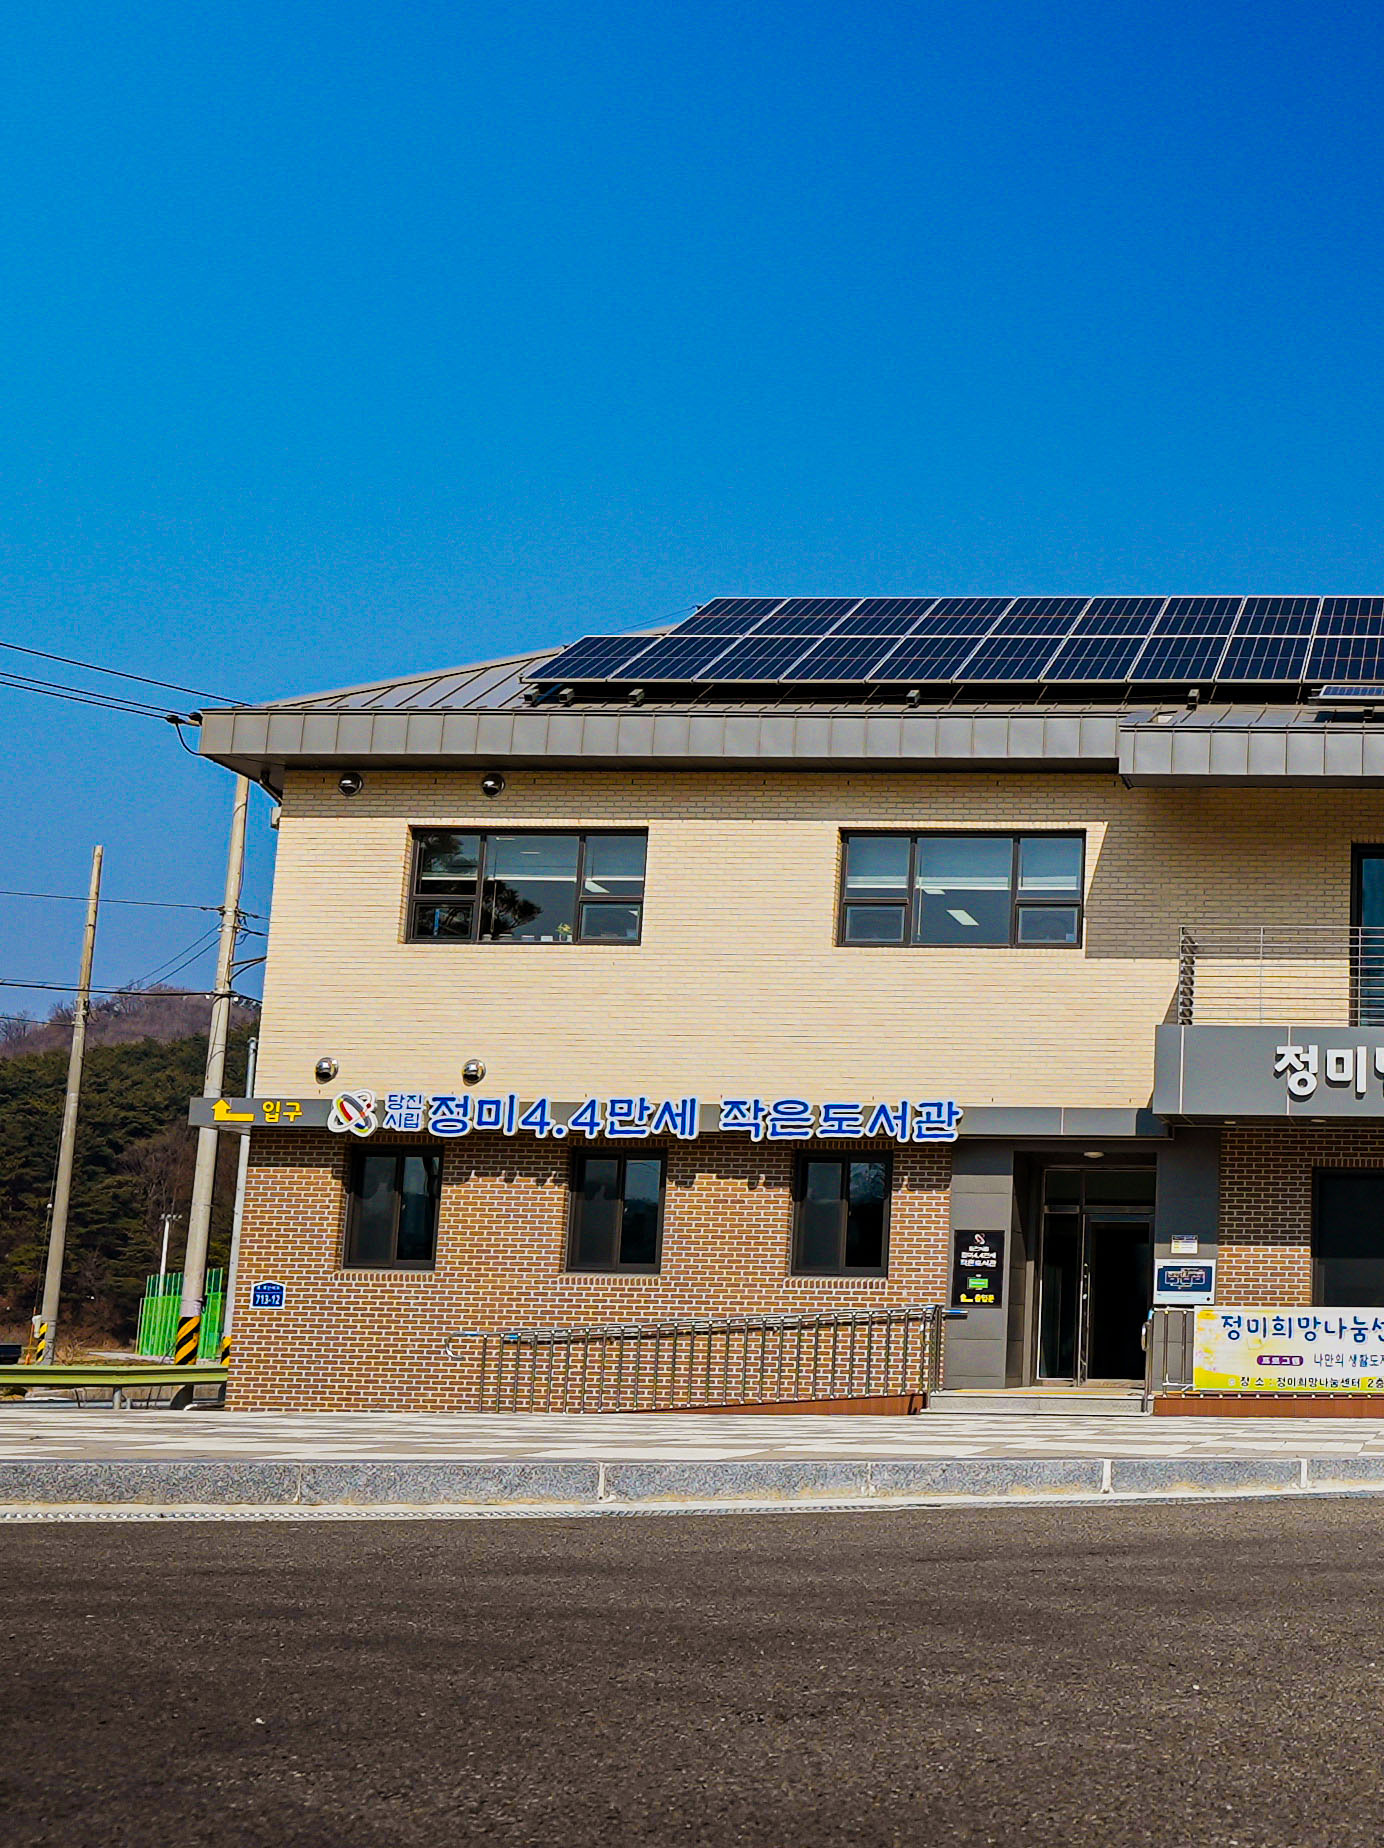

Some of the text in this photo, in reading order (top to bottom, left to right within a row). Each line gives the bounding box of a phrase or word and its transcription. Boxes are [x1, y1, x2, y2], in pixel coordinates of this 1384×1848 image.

[388, 1093, 423, 1111] 당진
[262, 1101, 303, 1123] 입구
[386, 1110, 421, 1130] 시립
[429, 1093, 962, 1140] 정미4.4만세 작은도서관
[255, 1294, 281, 1305] 713-12
[1313, 1353, 1344, 1368] 나만의
[1367, 1377, 1384, 1389] 2층
